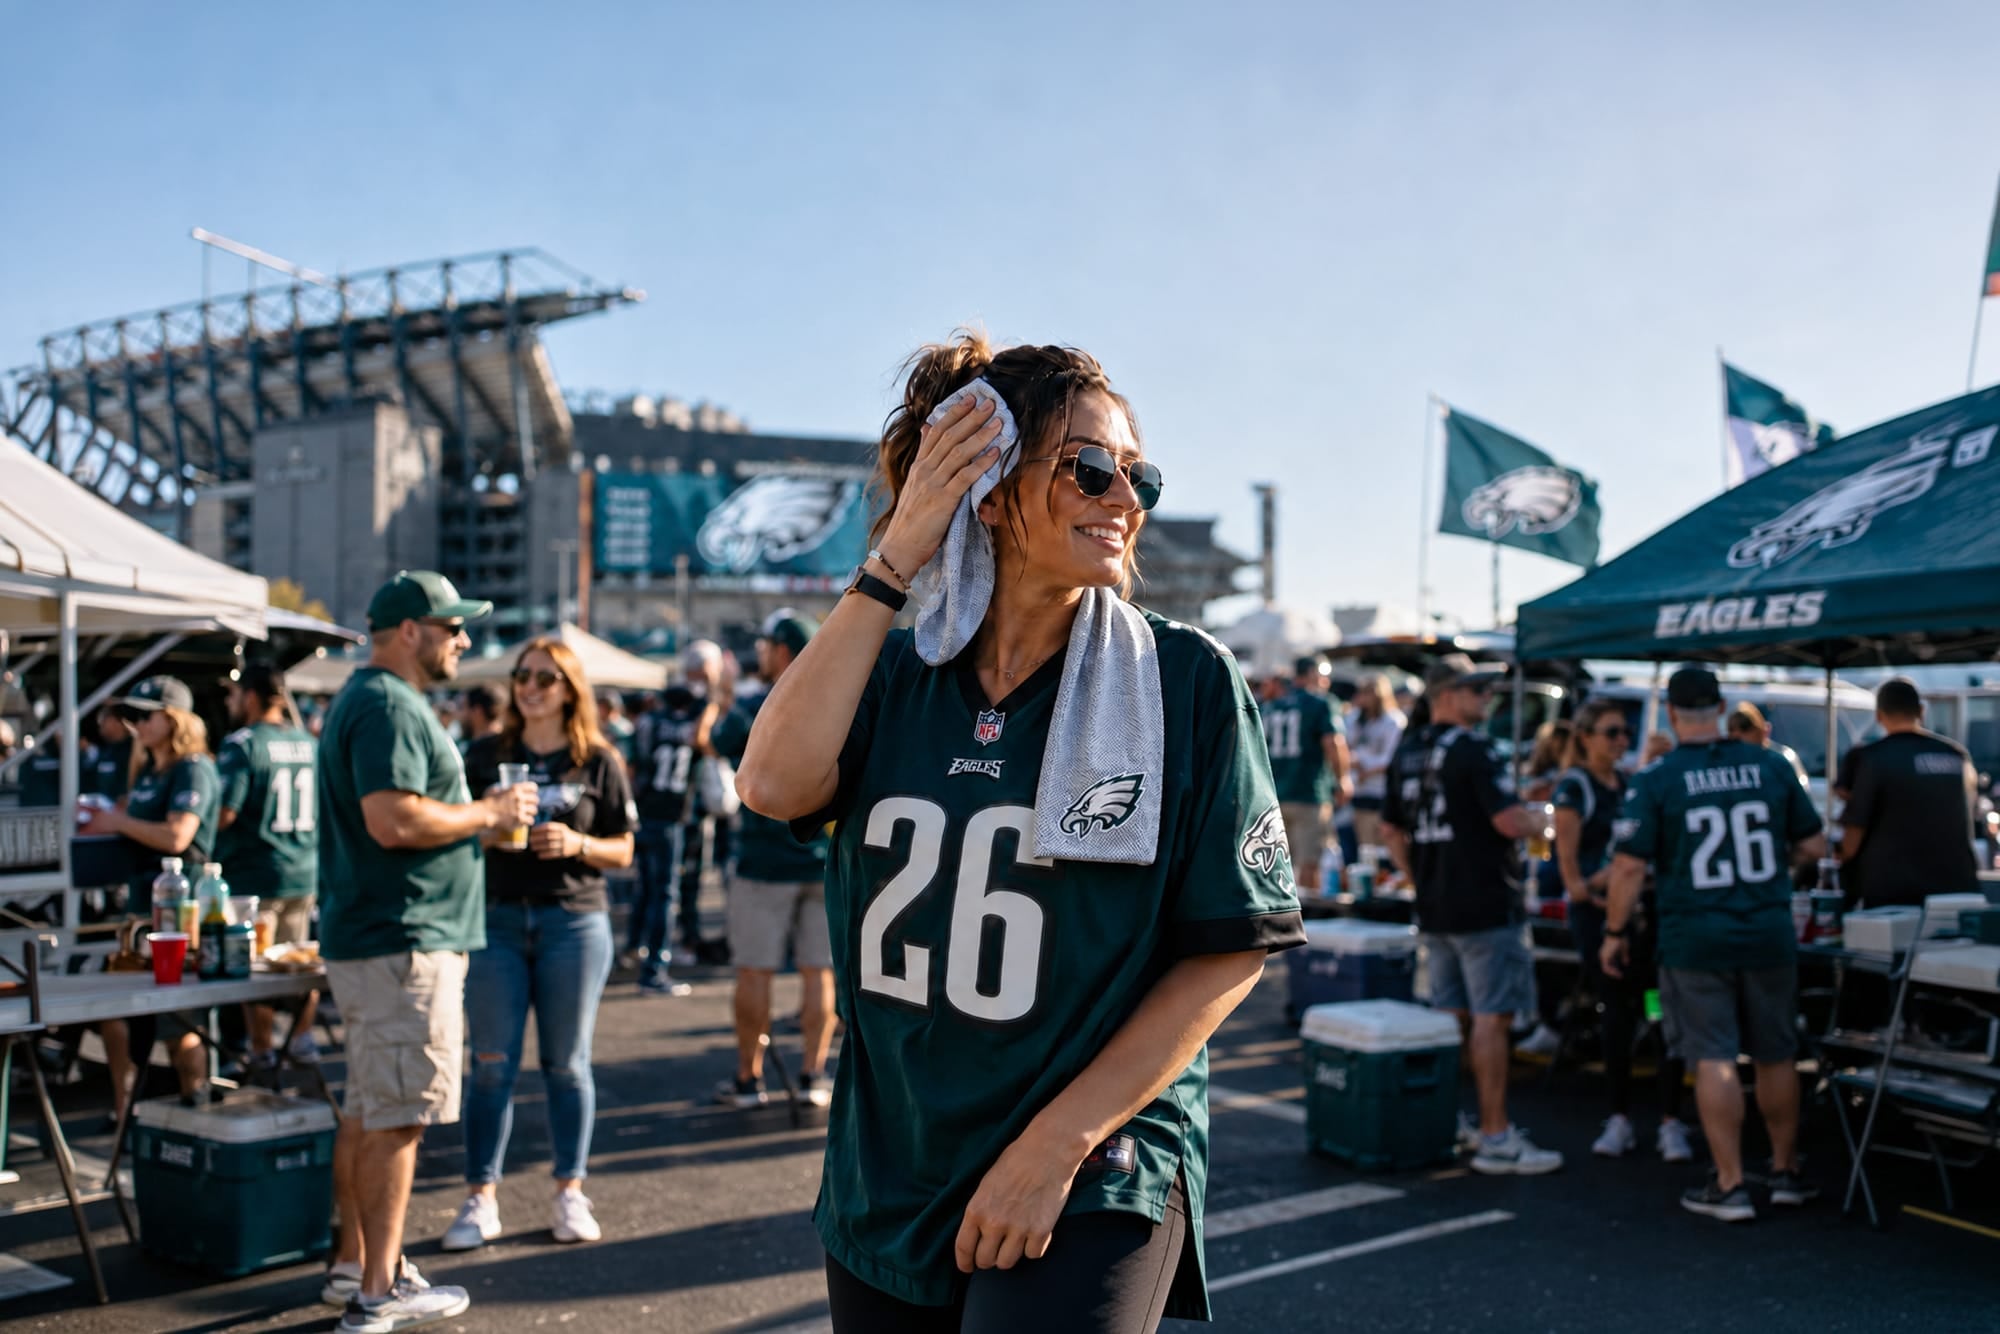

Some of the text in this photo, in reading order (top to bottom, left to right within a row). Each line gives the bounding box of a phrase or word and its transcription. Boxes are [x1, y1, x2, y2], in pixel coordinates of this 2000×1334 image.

[1654, 591, 1826, 639] EAGLES
[978, 723, 1000, 739] NFL
[947, 758, 1006, 779] EAGLES
[270, 767, 315, 832] 11
[1684, 800, 1777, 890] 26
[860, 797, 1053, 1021] 26
